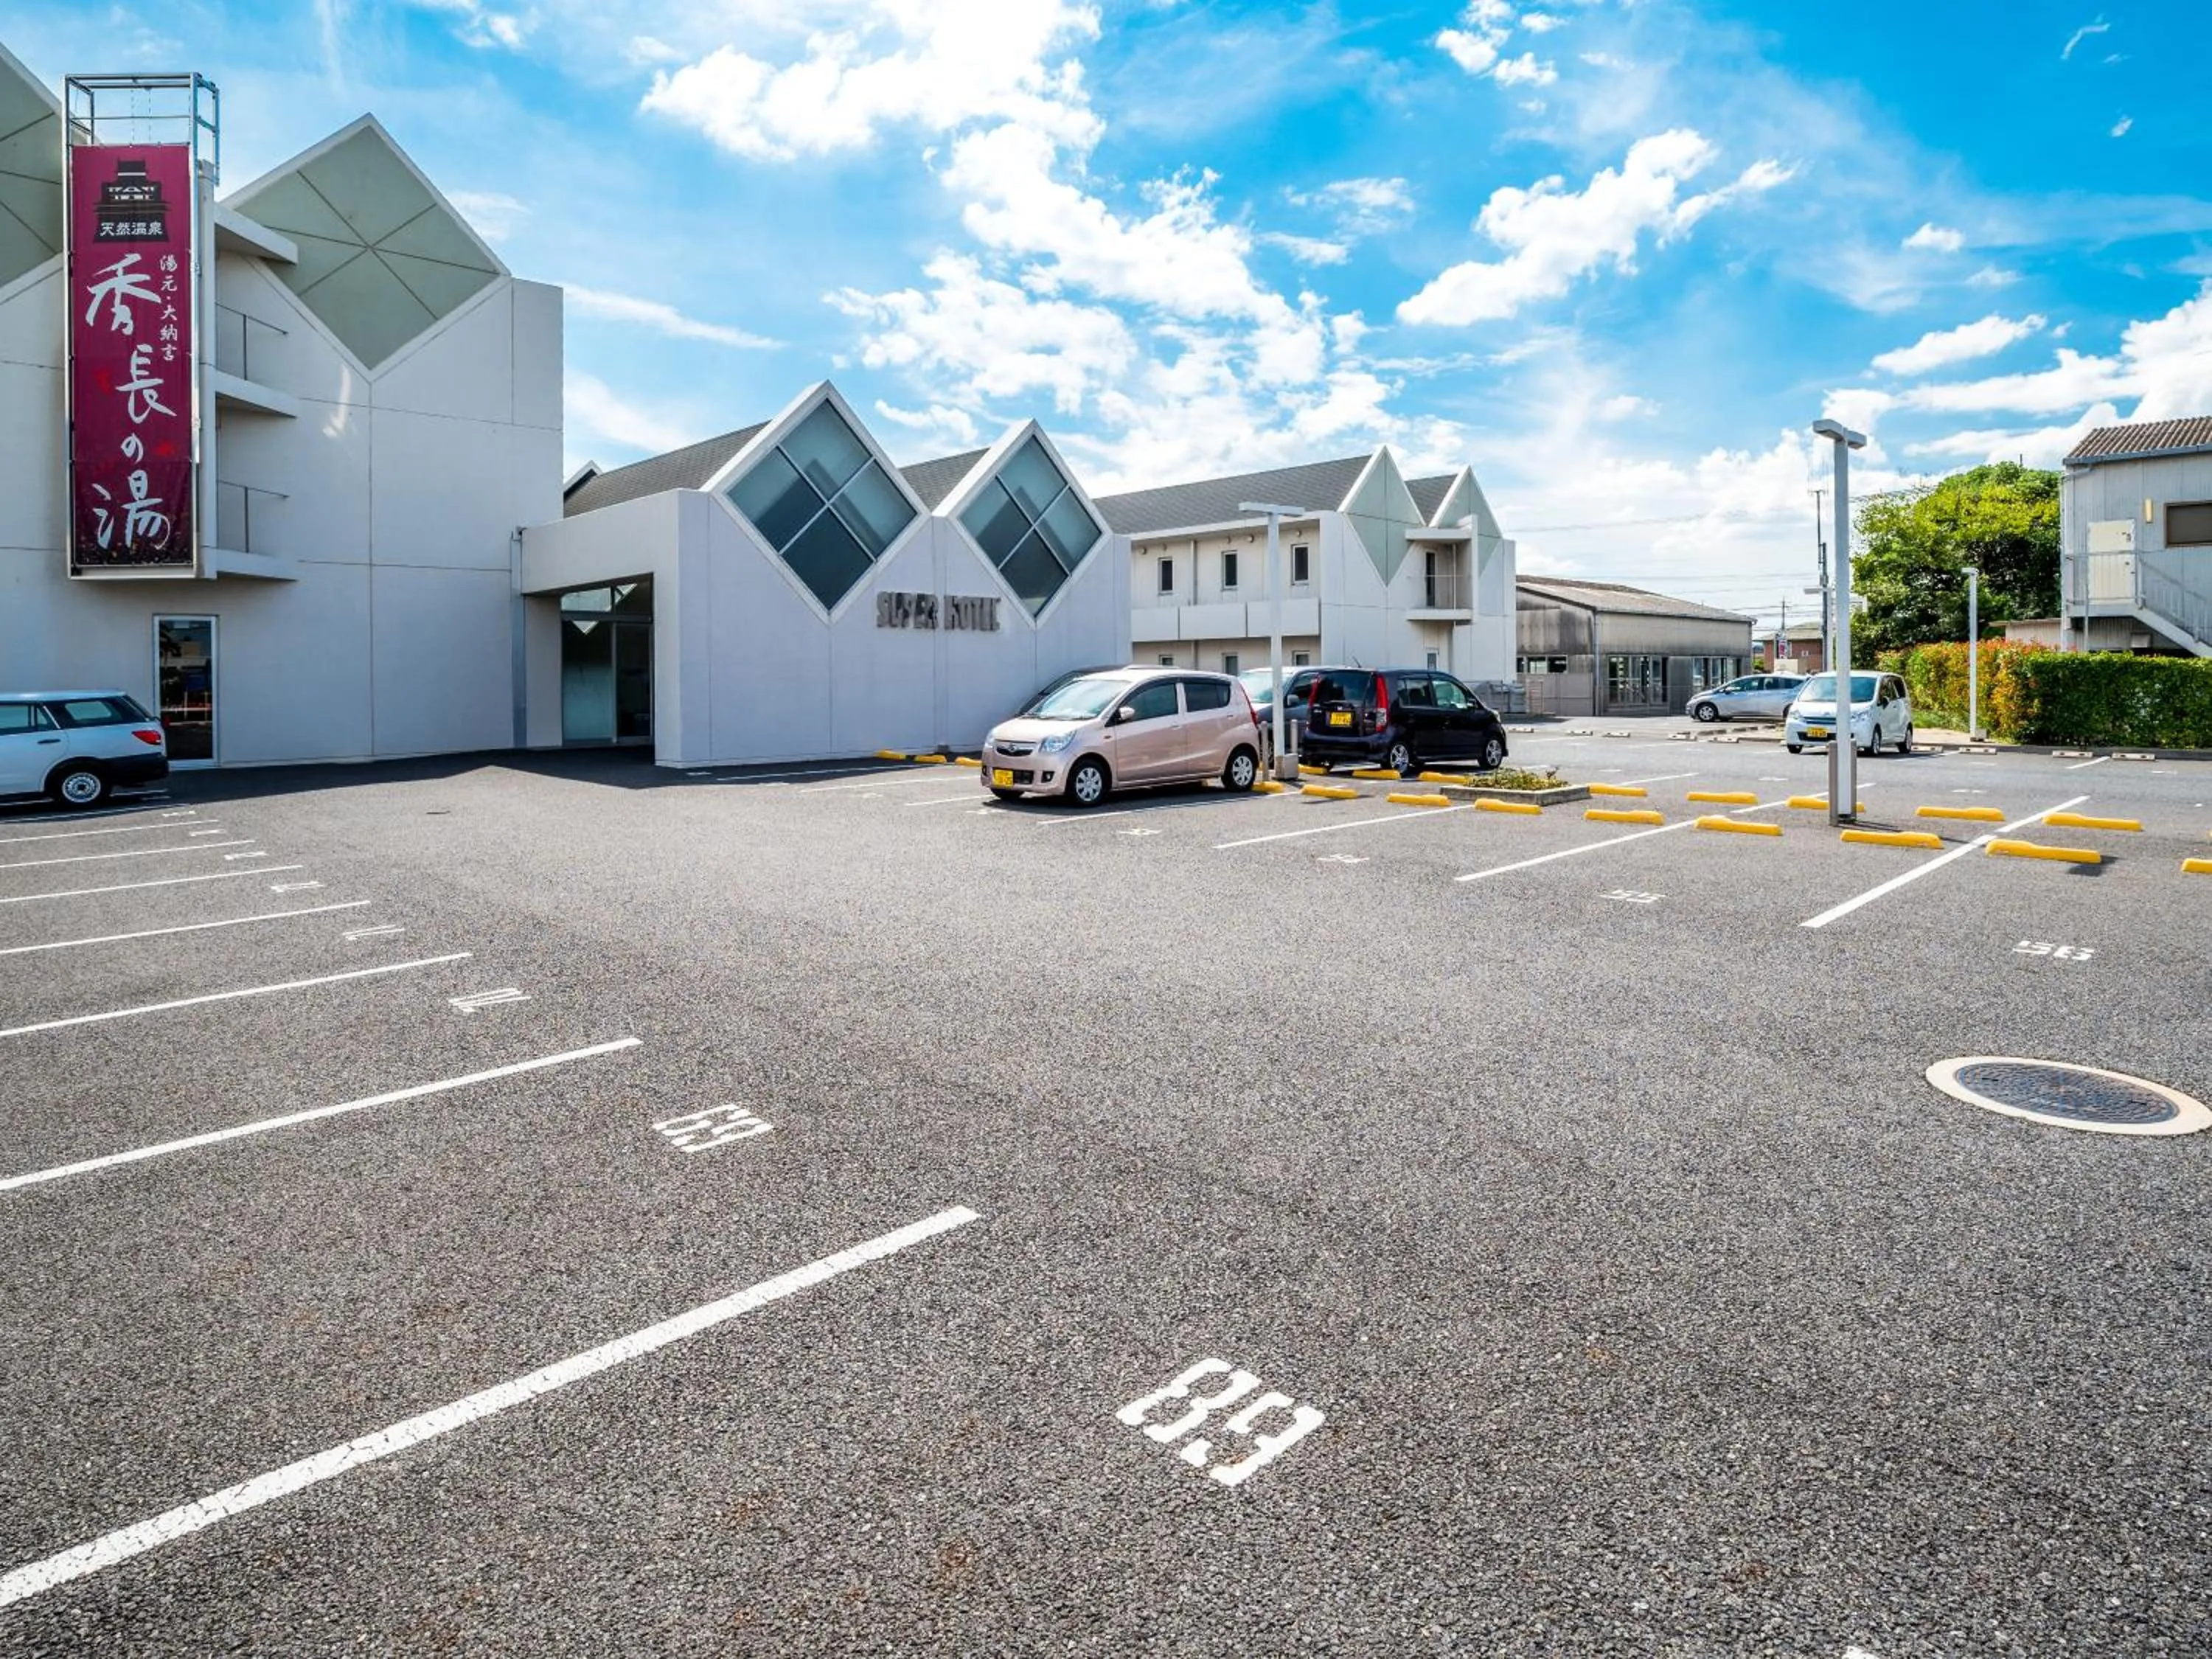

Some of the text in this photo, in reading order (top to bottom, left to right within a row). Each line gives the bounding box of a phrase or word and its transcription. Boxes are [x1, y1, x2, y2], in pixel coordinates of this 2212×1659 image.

[100, 221, 163, 237] 天然温泉
[86, 253, 177, 550] 香長の湯
